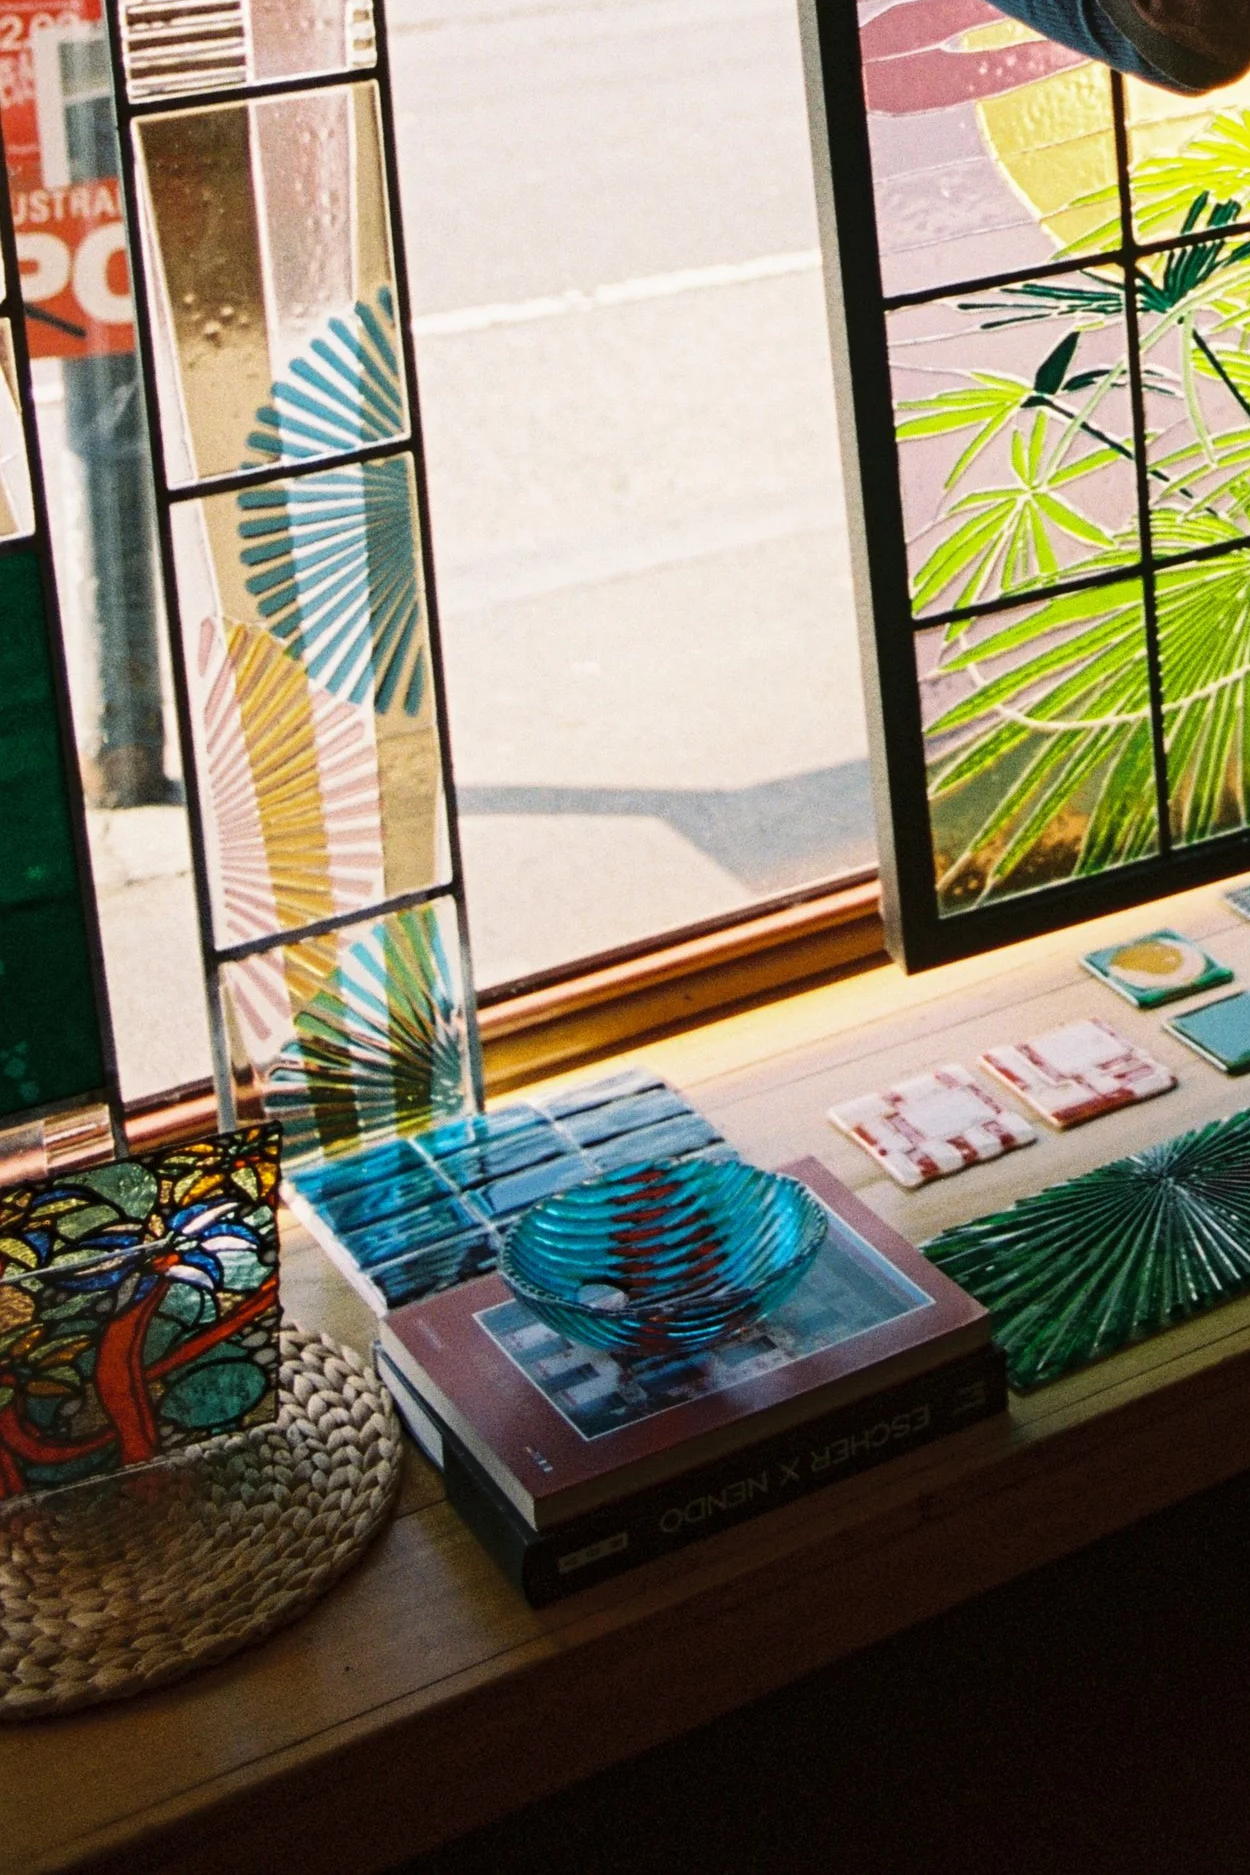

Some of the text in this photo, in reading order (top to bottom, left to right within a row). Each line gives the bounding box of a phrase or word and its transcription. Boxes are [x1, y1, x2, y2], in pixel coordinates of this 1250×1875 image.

[13, 185, 120, 226] USTRA
[658, 1403, 932, 1534] ESCHER X NENDO
